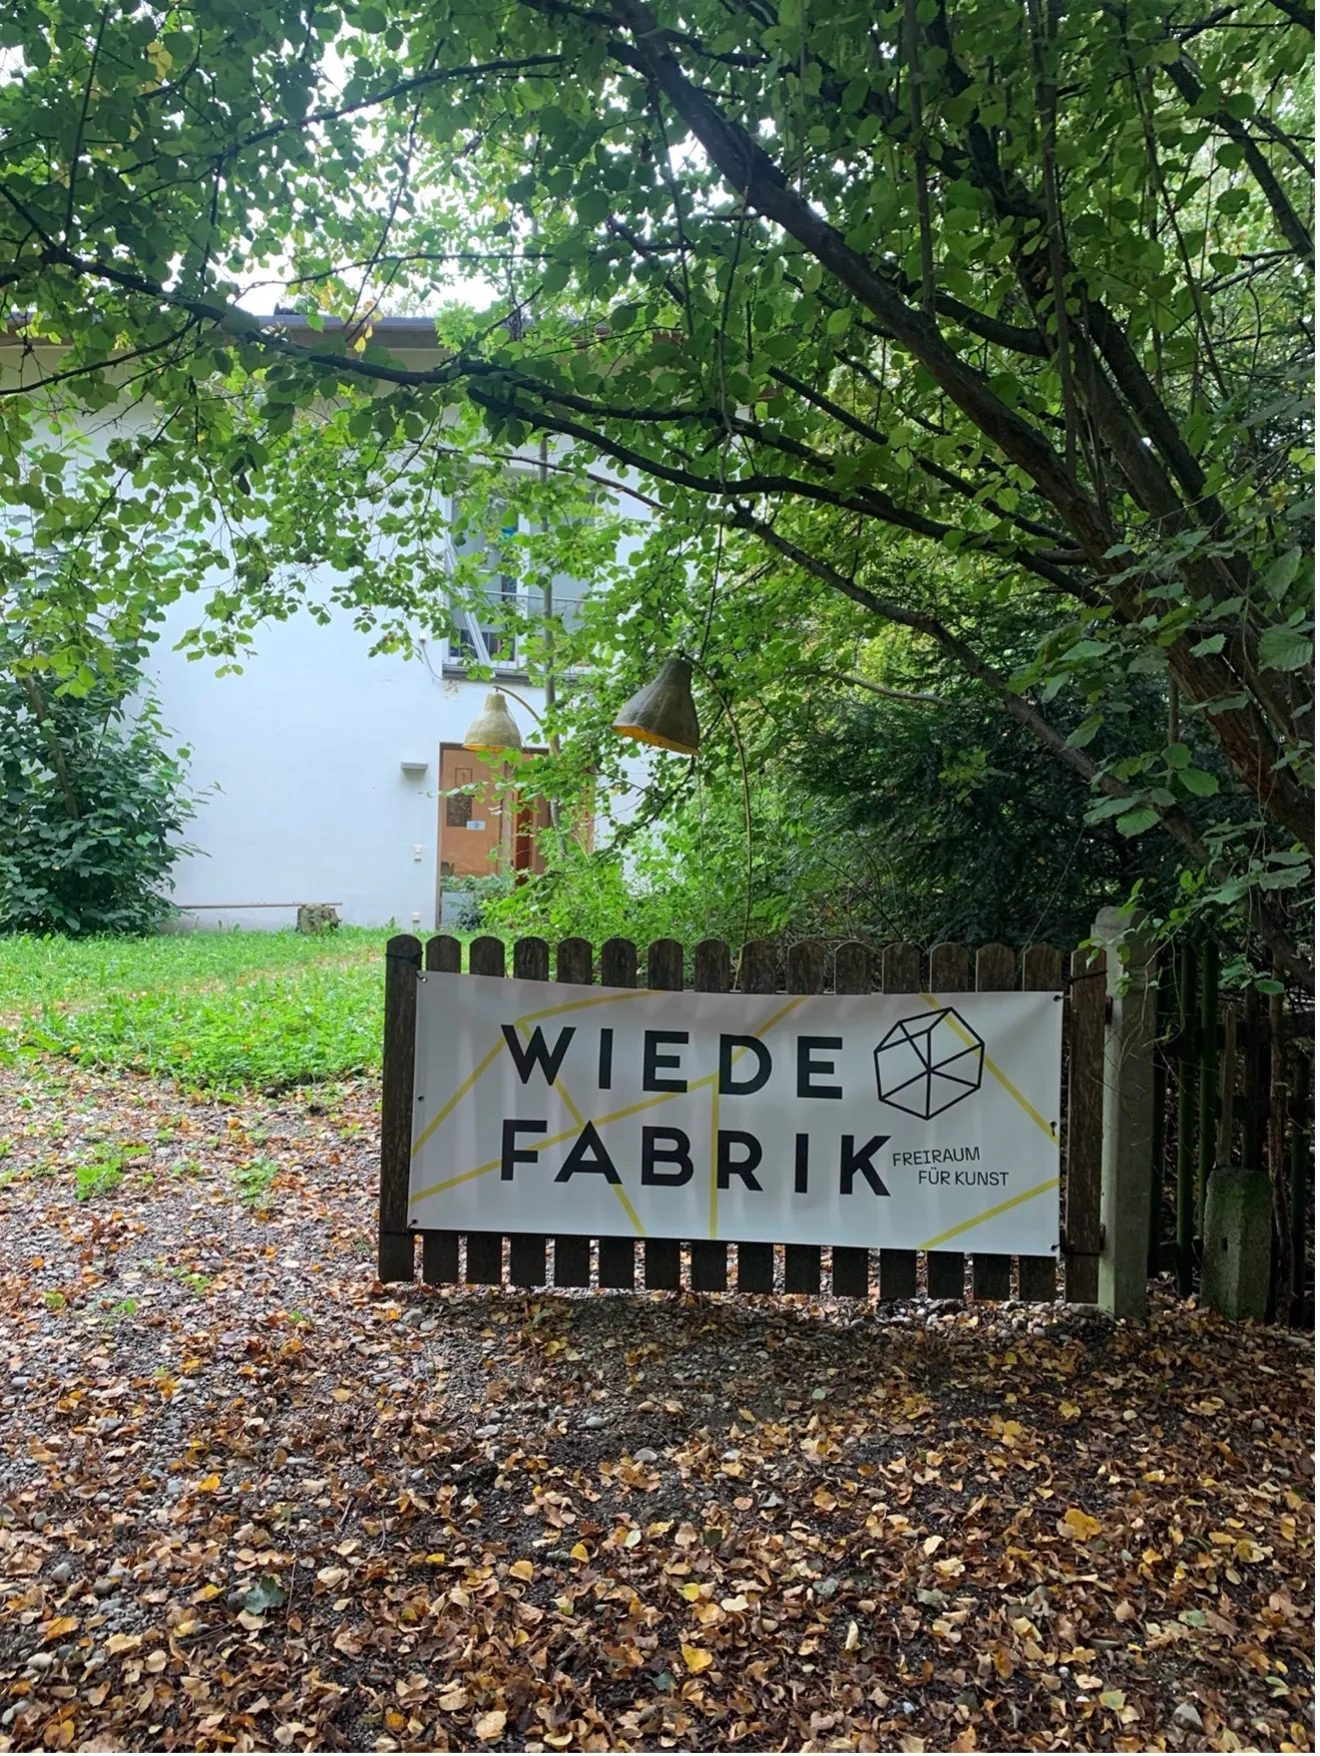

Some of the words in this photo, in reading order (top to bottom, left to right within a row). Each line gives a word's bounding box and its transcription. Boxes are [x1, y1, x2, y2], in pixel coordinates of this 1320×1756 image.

[500, 1024, 844, 1100] WIEDE
[499, 1119, 892, 1197] FABRIK
[892, 1146, 981, 1166] FREIRAUM
[918, 1166, 951, 1186] FÜR
[955, 1170, 1009, 1187] KUNST
